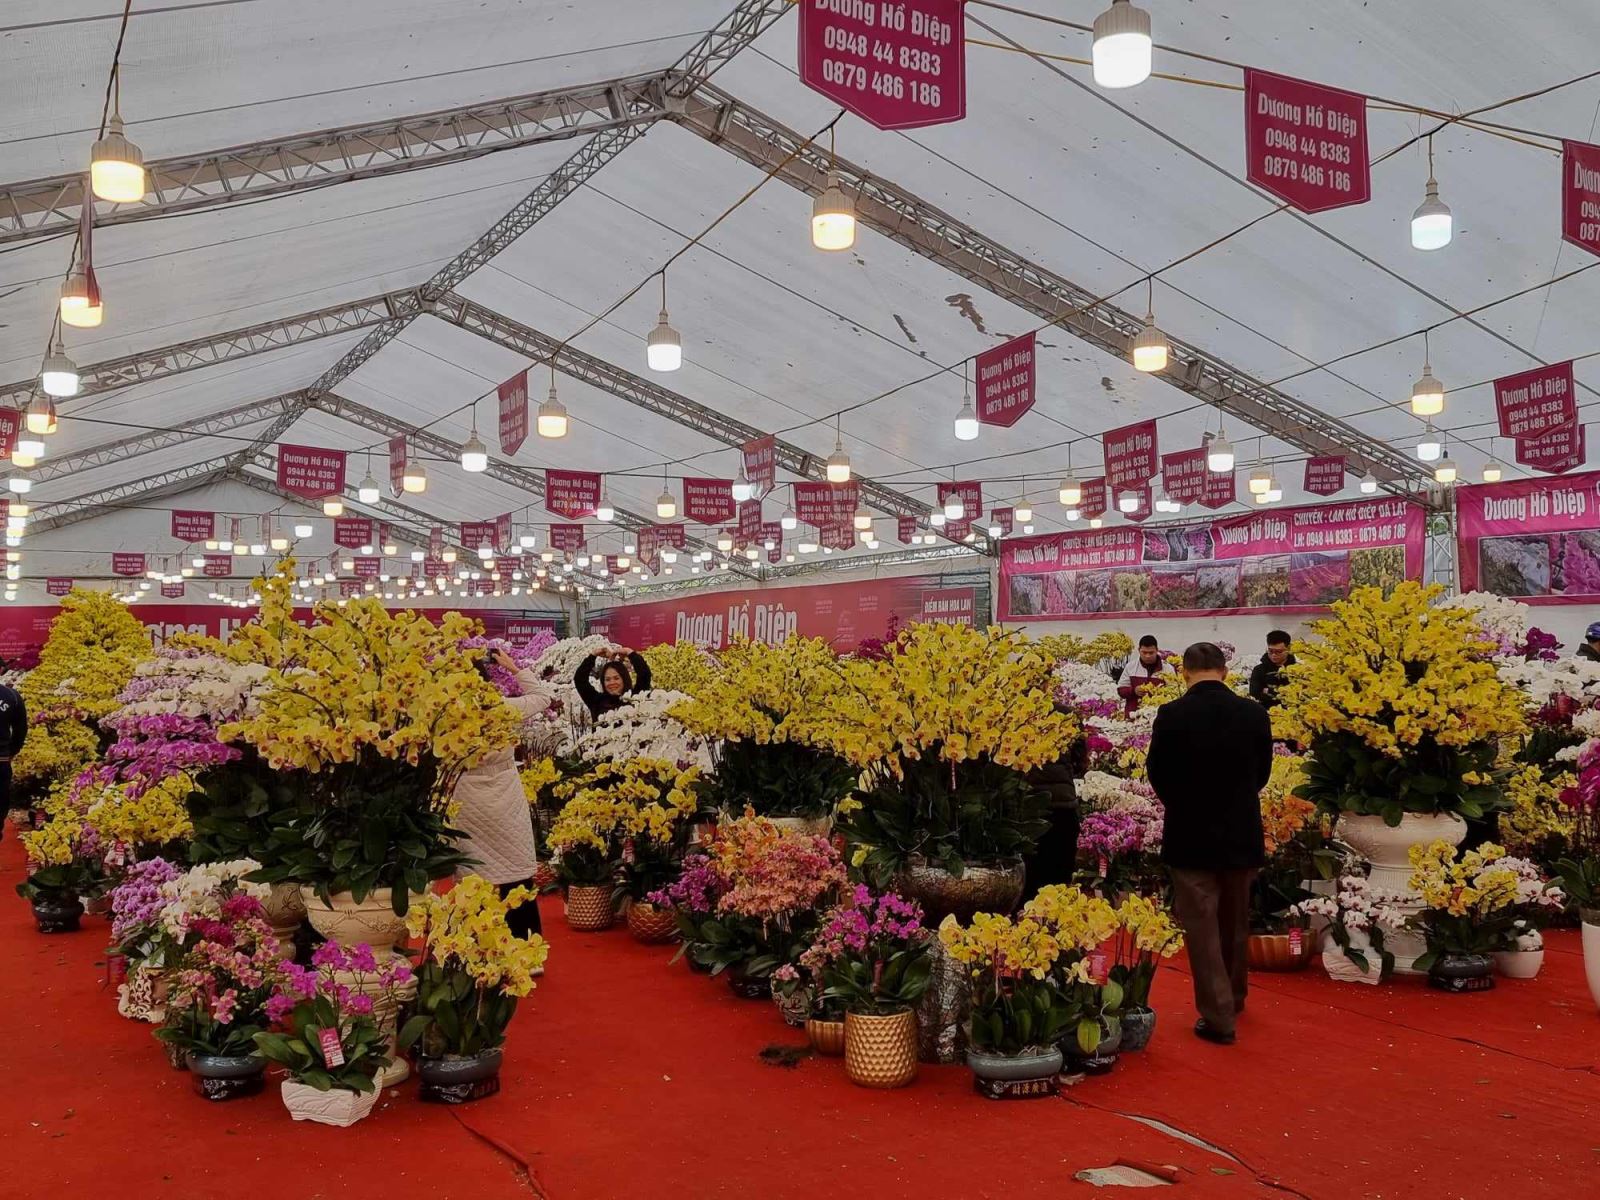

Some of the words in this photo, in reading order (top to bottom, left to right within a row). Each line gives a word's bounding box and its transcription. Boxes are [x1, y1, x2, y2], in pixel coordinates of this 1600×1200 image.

[881, 3, 905, 31] Hồ
[911, 10, 951, 46] Điệp
[824, 26, 867, 57] 0948
[873, 40, 894, 65] 44
[899, 46, 941, 76] 8383
[822, 59, 867, 90] 0879
[871, 71, 904, 100] 486
[910, 80, 941, 107] 186
[1258, 93, 1301, 126] Dương
[1306, 104, 1324, 129] Hồ
[1327, 110, 1357, 139] Điệp
[1265, 128, 1297, 152] 0948
[1301, 137, 1317, 157] 44
[1320, 140, 1350, 165] 8383
[1264, 155, 1297, 180] 0879
[1301, 165, 1324, 186] 486
[1328, 169, 1350, 192] 186
[1502, 388, 1529, 407] Dương
[1530, 378, 1543, 399] Hồ
[1545, 376, 1567, 398] Điệp
[1509, 408, 1528, 422] 0948
[1529, 405, 1539, 416] 44
[1541, 400, 1563, 414] 8383
[1511, 420, 1529, 435] 0879
[1530, 417, 1545, 430] 486
[1548, 413, 1564, 426] 186
[1328, 509, 1344, 523] LAN
[1484, 497, 1526, 521] Dương
[1530, 487, 1549, 517] Hồ
[1552, 488, 1586, 520] Điệp
[1218, 526, 1249, 545] Dương
[1264, 518, 1287, 543] Điệp
[1306, 531, 1323, 547] 0948
[1325, 530, 1334, 545] 44
[1335, 529, 1353, 545] 8383
[1359, 526, 1377, 543] 0879
[1378, 525, 1392, 541] 486
[1394, 523, 1406, 539] 186
